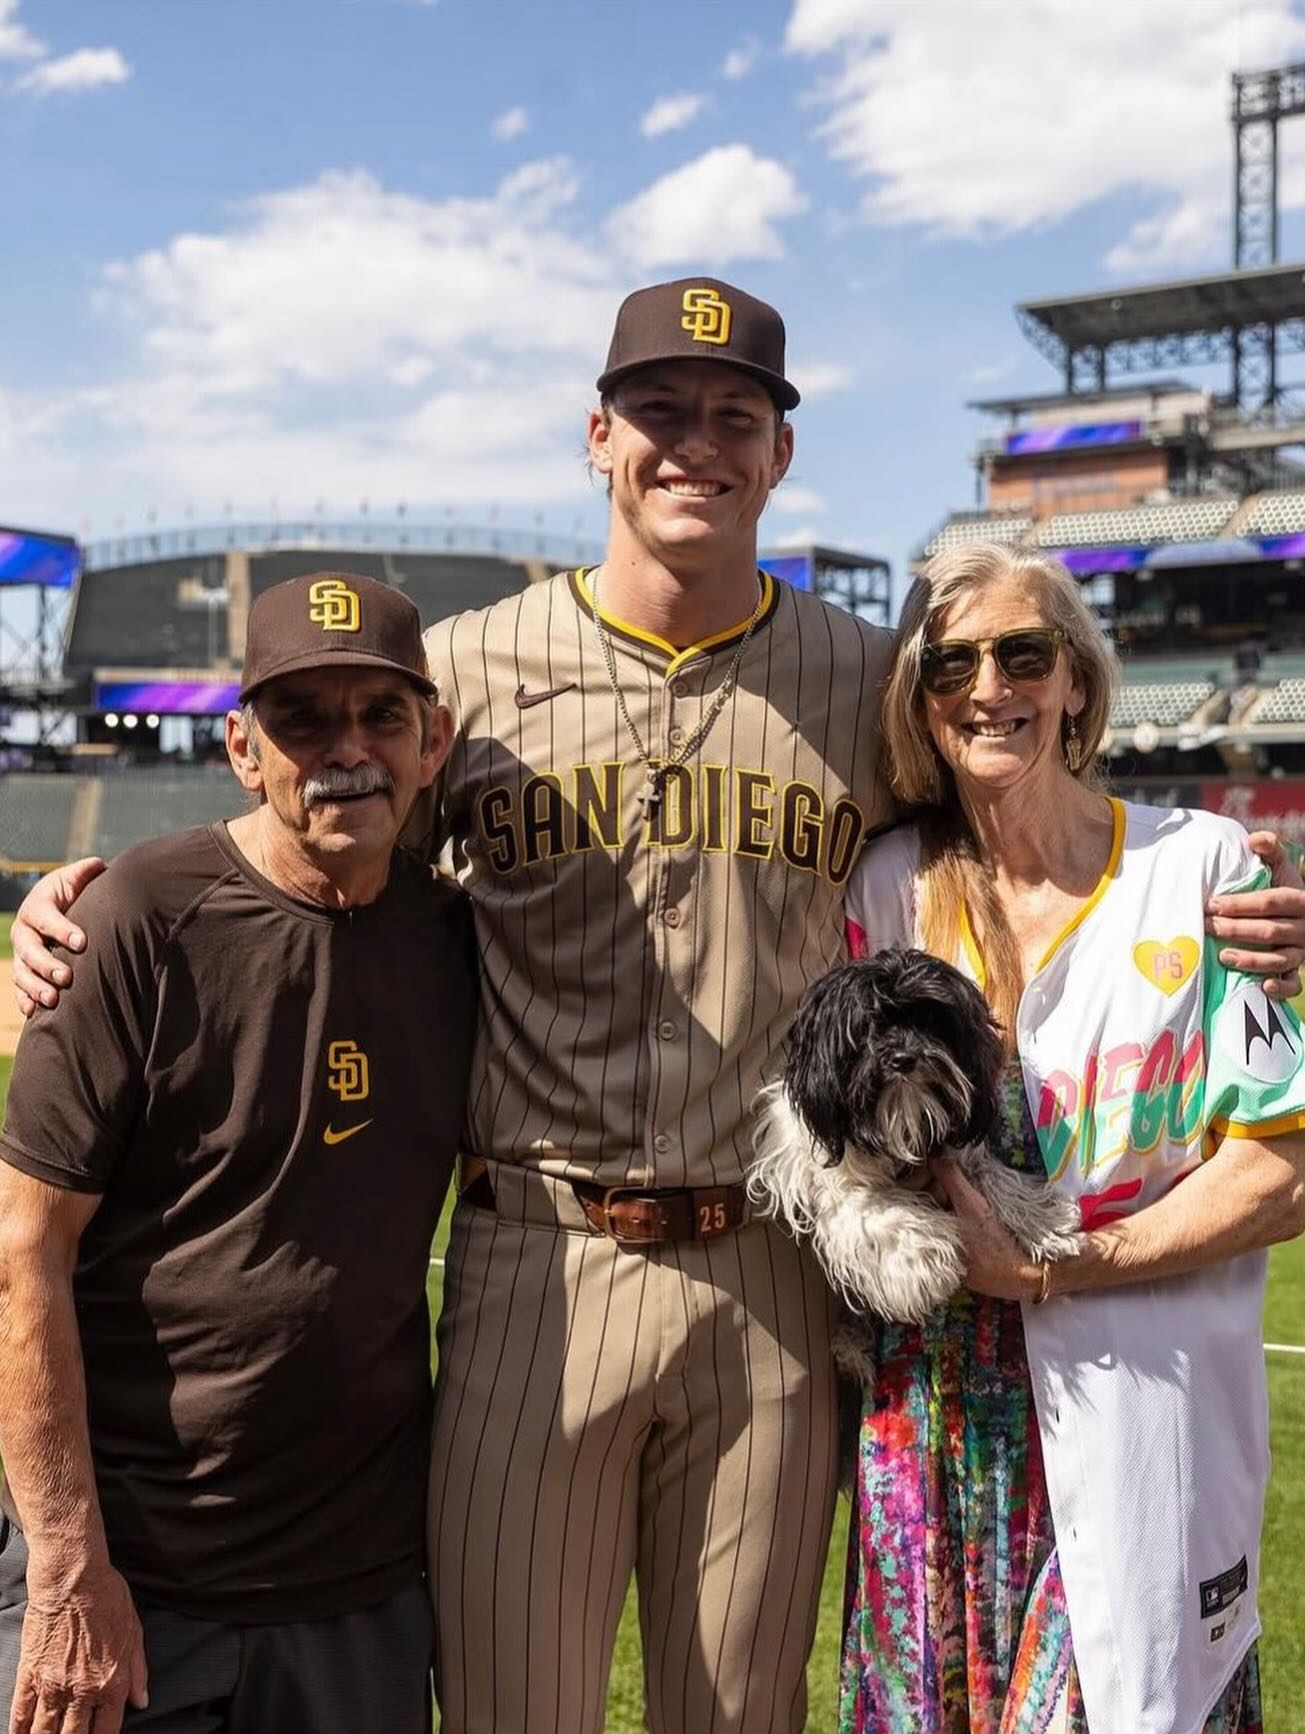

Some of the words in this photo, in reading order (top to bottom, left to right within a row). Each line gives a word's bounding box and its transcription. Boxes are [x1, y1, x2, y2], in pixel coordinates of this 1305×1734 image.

[681, 287, 732, 346] SD
[309, 579, 360, 631] SD
[478, 760, 626, 876] SAN
[643, 757, 864, 885] DIEGO
[1153, 950, 1184, 980] PS
[328, 1040, 369, 1101] SD
[1035, 1027, 1206, 1185] DIEGO
[700, 1202, 726, 1233] 25
